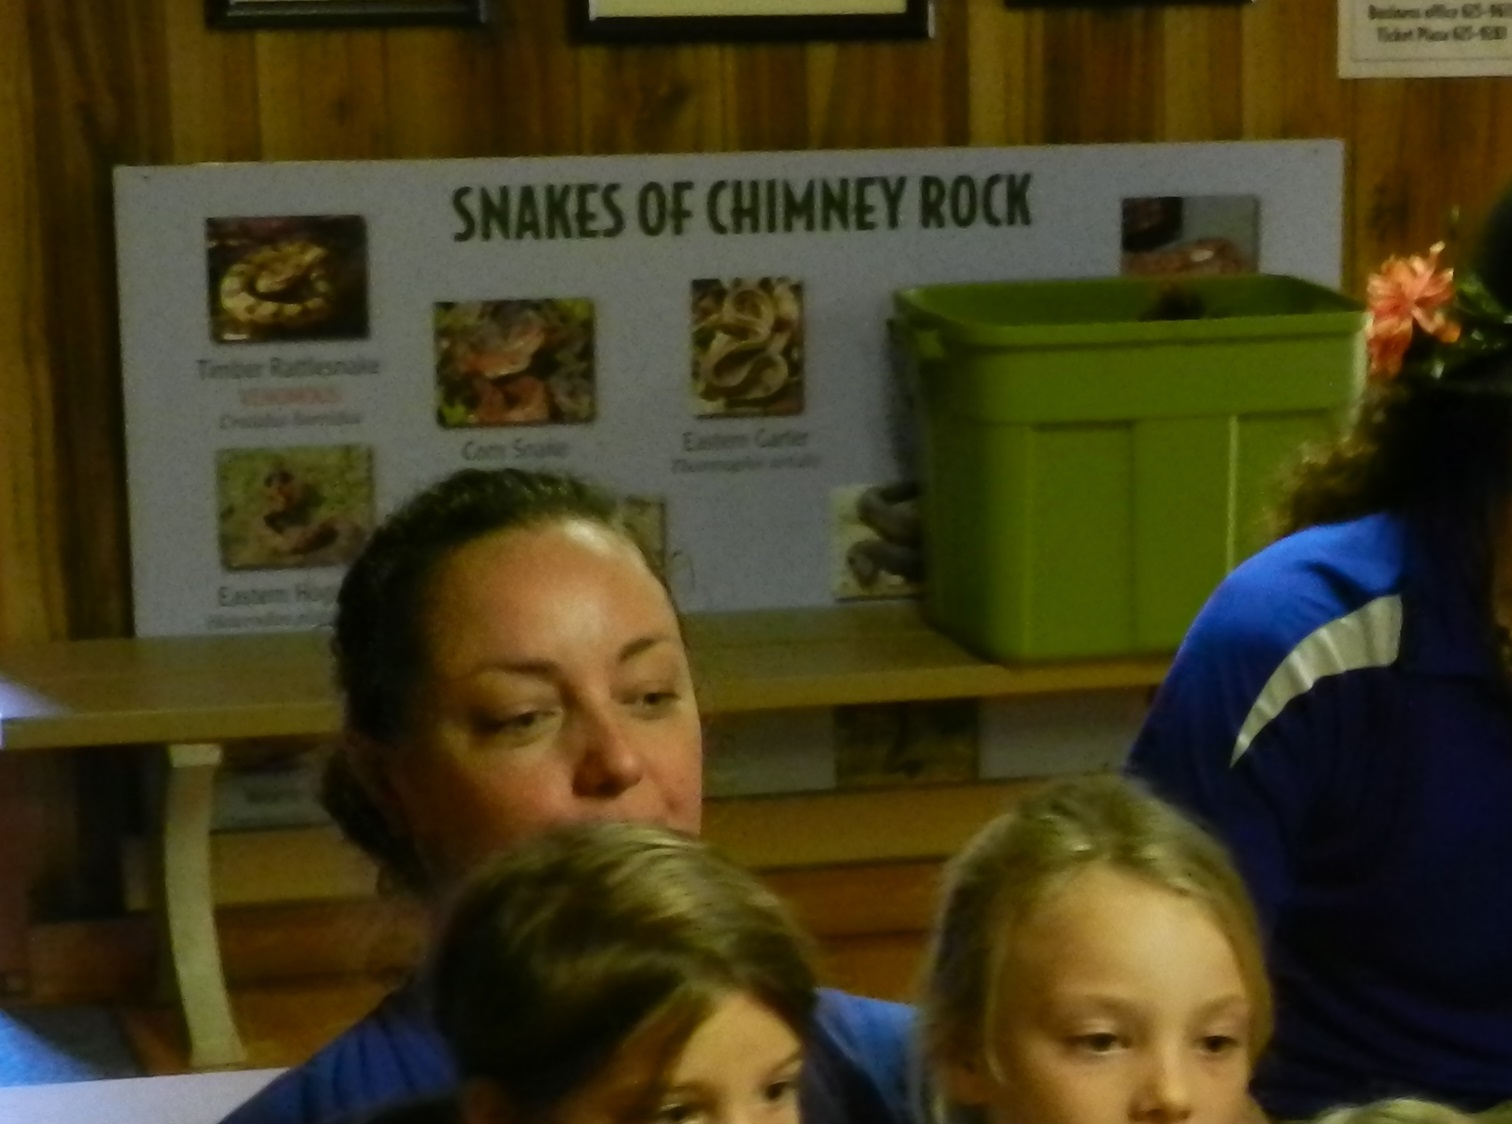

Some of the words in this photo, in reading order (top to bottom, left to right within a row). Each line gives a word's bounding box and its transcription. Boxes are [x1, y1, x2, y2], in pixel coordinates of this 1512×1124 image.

[452, 182, 624, 243] SNAKES
[637, 180, 694, 237] OF
[706, 175, 908, 236] CHIMNEY
[920, 172, 1034, 229] ROCK
